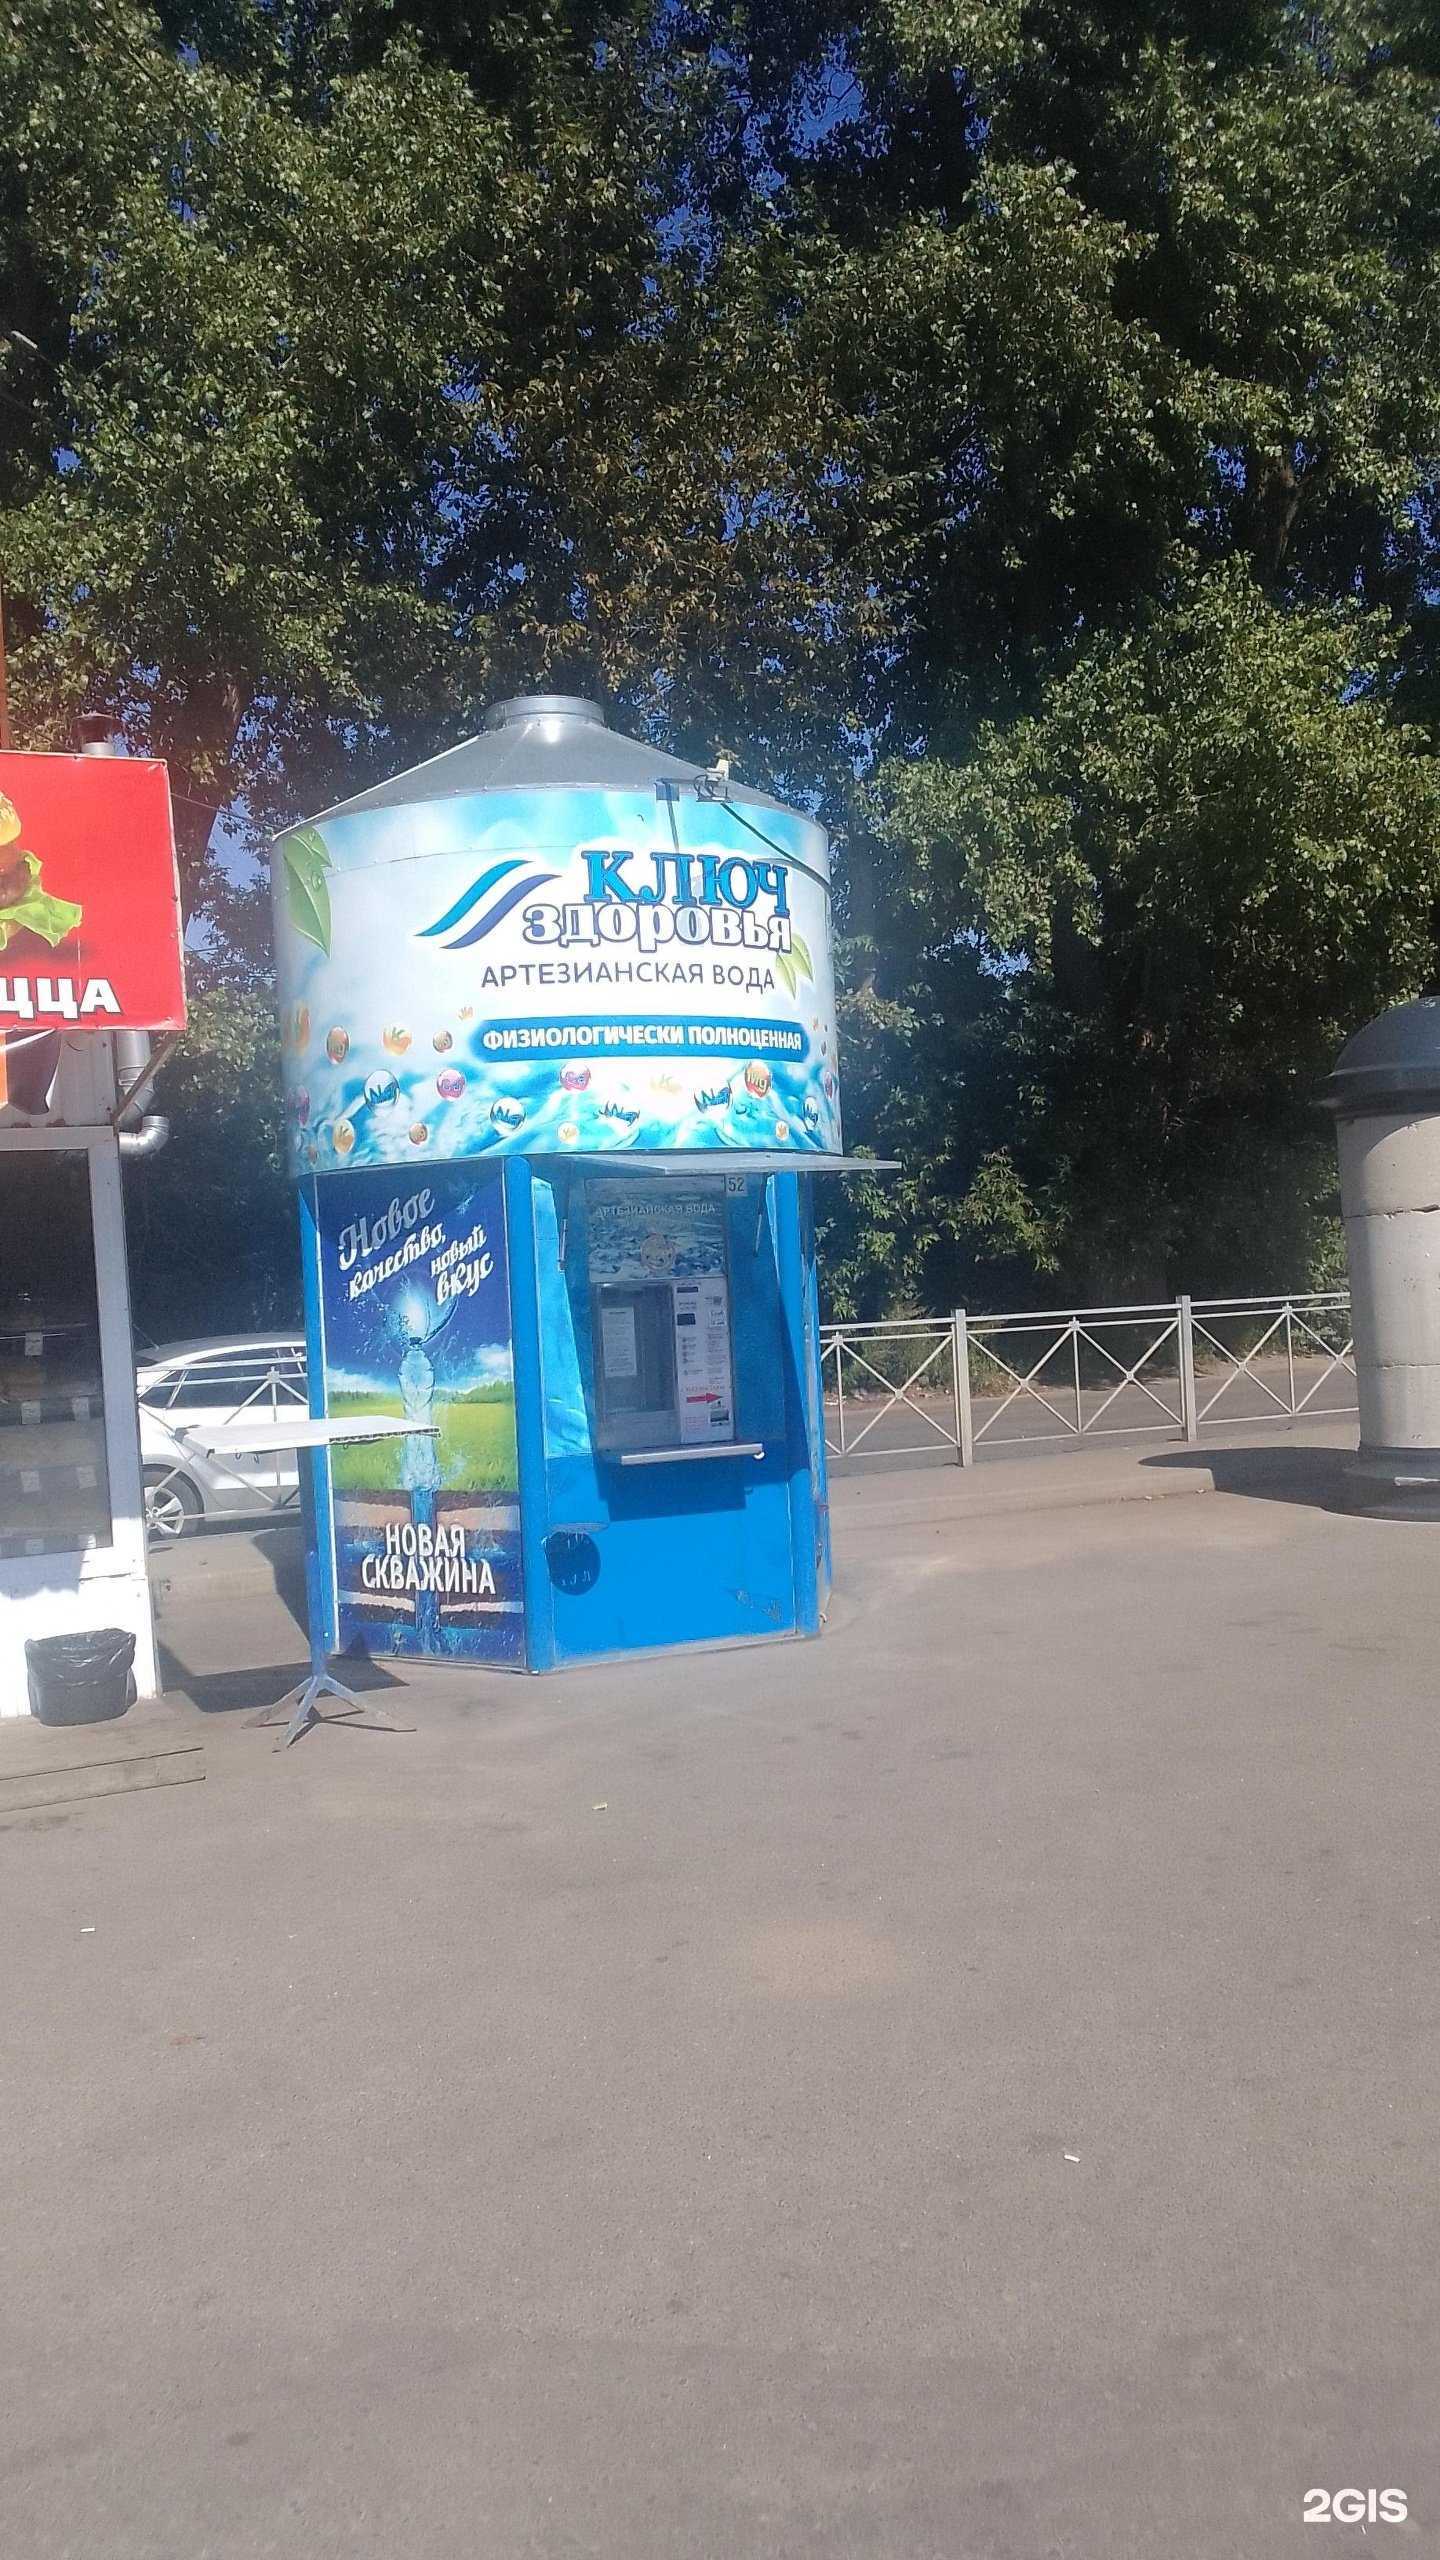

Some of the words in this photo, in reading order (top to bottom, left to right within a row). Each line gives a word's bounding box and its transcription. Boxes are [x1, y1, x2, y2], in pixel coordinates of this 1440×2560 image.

[581, 850, 790, 916] КЛЮЧ
[481, 961, 703, 988] АРТЕЗИАНСКАЯ
[712, 964, 775, 994] ВОДА
[483, 1024, 684, 1050] ФИЗИОЛОГИЧЕСКИ
[687, 1025, 802, 1051] ПОЛНОЦЕННАЯ
[728, 1177, 745, 1192] 52
[338, 1188, 435, 1271] Новое
[430, 1224, 487, 1278] новый
[349, 1222, 446, 1301] качество,
[436, 1253, 494, 1306] вкус
[385, 1522, 466, 1558] НОВАЯ
[361, 1553, 496, 1595] СКВАЖИНА
